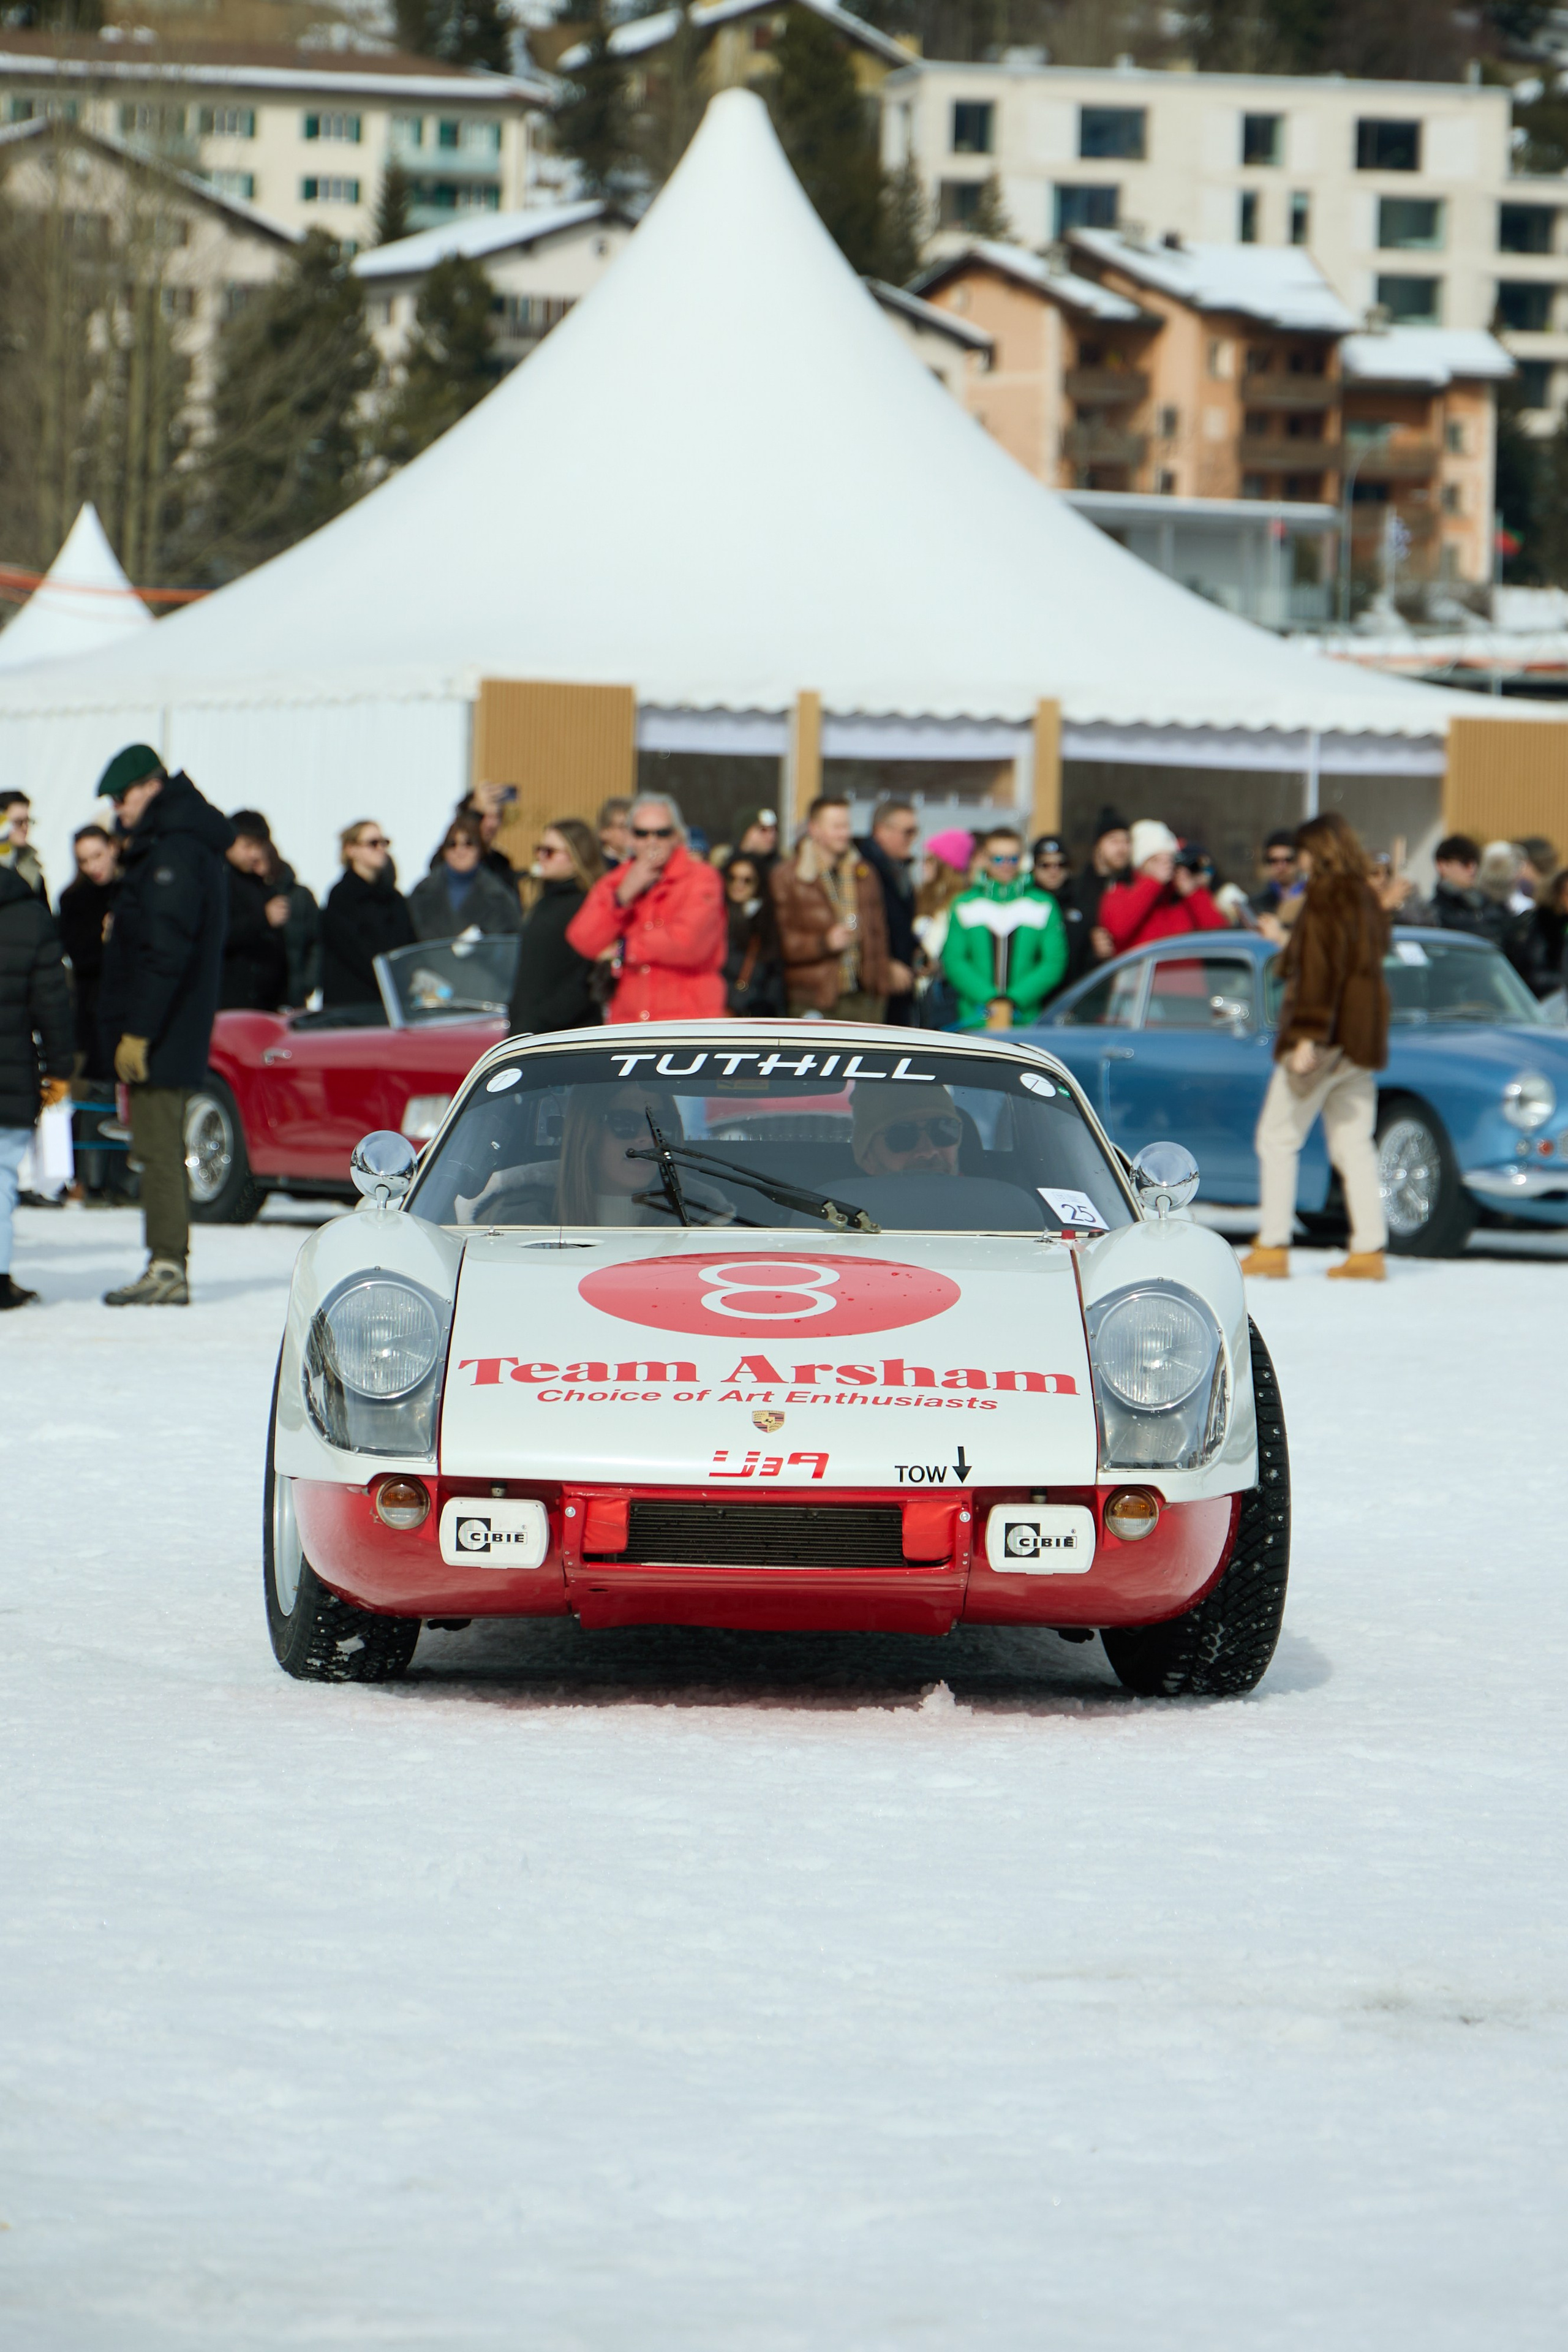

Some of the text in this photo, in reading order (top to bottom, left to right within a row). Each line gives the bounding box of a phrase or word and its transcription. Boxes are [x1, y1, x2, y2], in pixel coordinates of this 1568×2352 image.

[611, 1053, 937, 1081] TUTHILL
[1061, 1204, 1096, 1223] 25
[697, 1261, 840, 1321] 8
[458, 1354, 1080, 1396] Team Arsham
[537, 1389, 998, 1410] Choice of Art Enthusiasts
[894, 1465, 947, 1483] TOW
